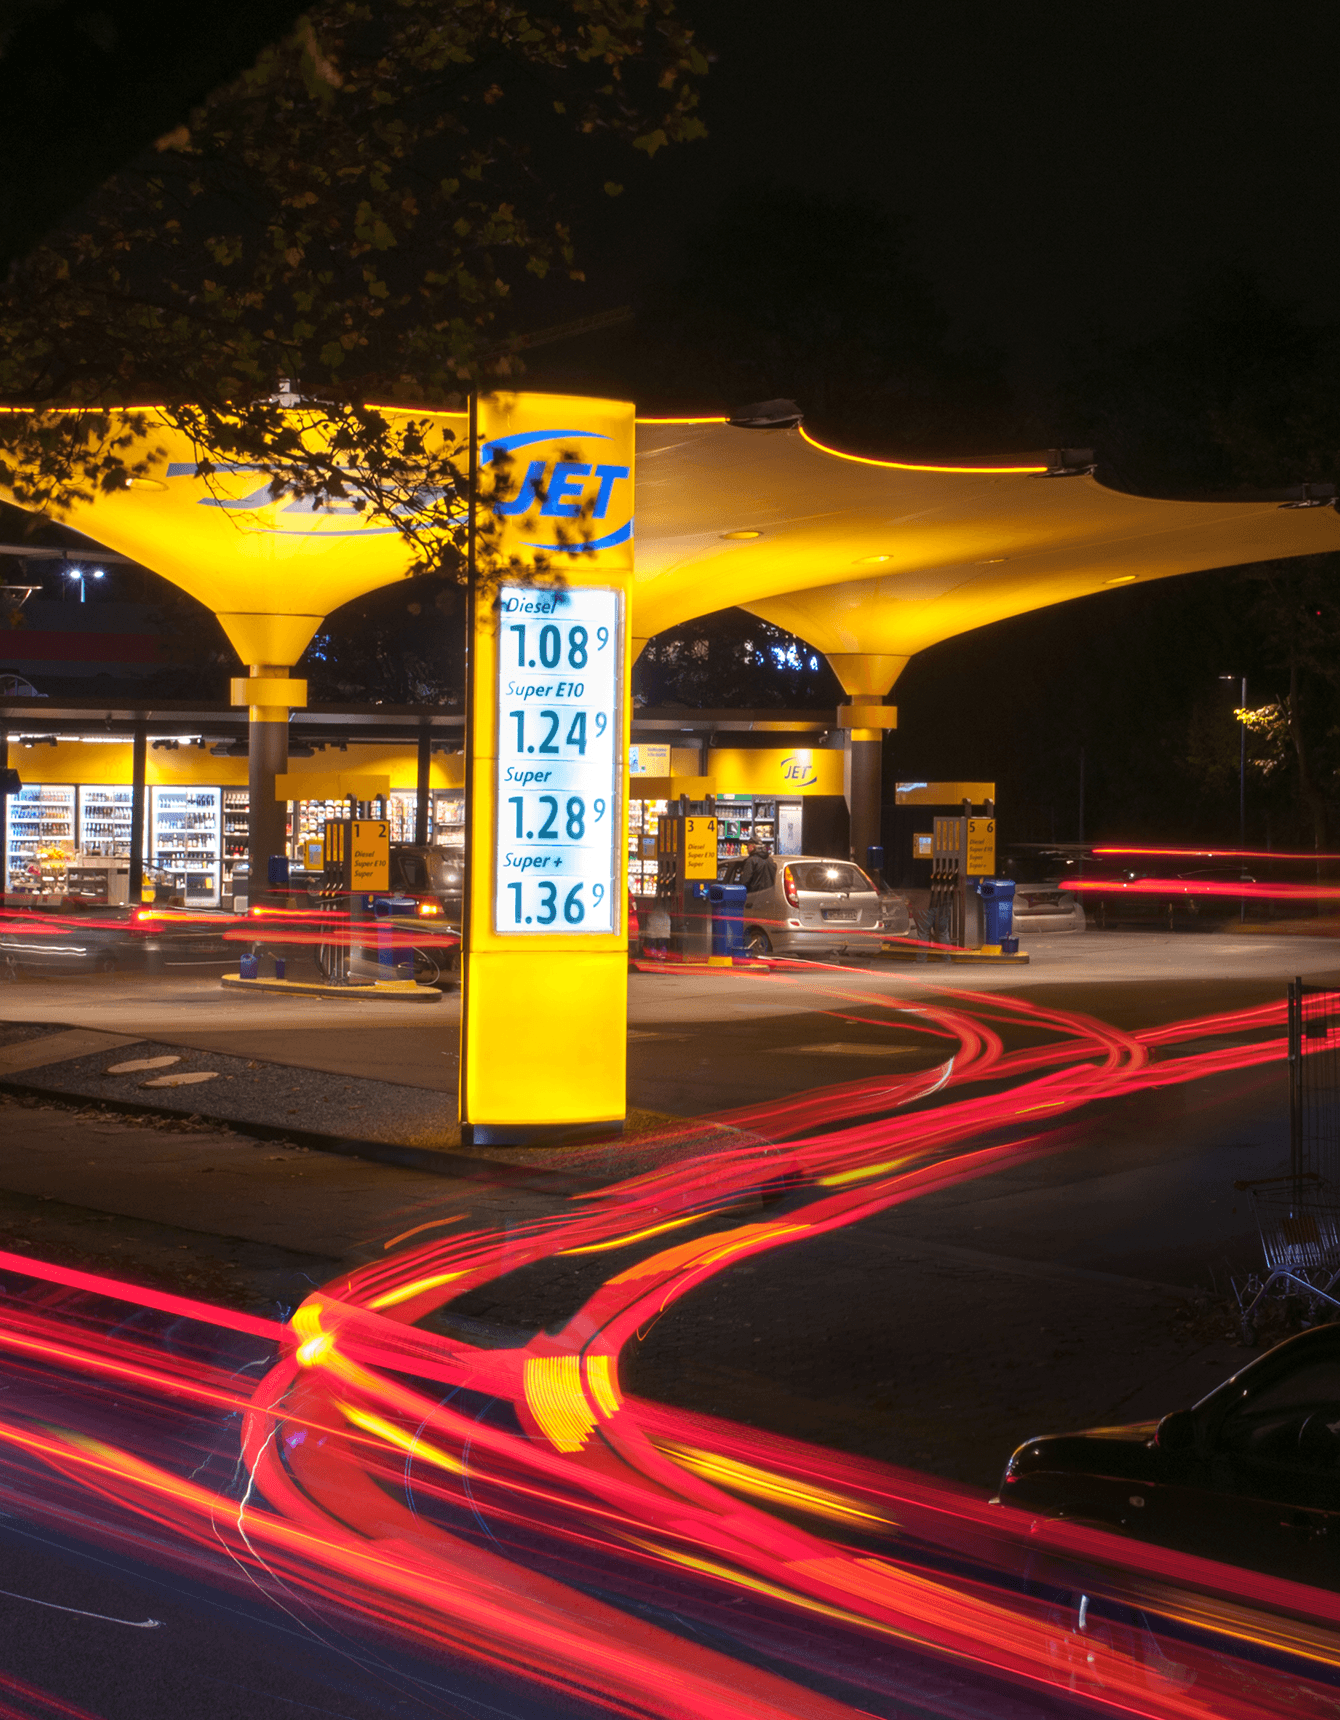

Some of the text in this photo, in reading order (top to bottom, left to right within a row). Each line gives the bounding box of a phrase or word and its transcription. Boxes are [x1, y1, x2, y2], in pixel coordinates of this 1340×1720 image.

[492, 460, 631, 519] JET
[507, 596, 558, 614] Diesel
[506, 680, 585, 701] Super E10
[504, 766, 553, 787] Super
[784, 765, 812, 779] JET
[354, 824, 386, 838] 1 2
[687, 820, 715, 832] 3 4
[969, 821, 994, 833] 5 6
[354, 850, 375, 858] Diesel
[354, 860, 373, 868] Super
[503, 852, 551, 873] Super
[354, 870, 374, 879] Super
